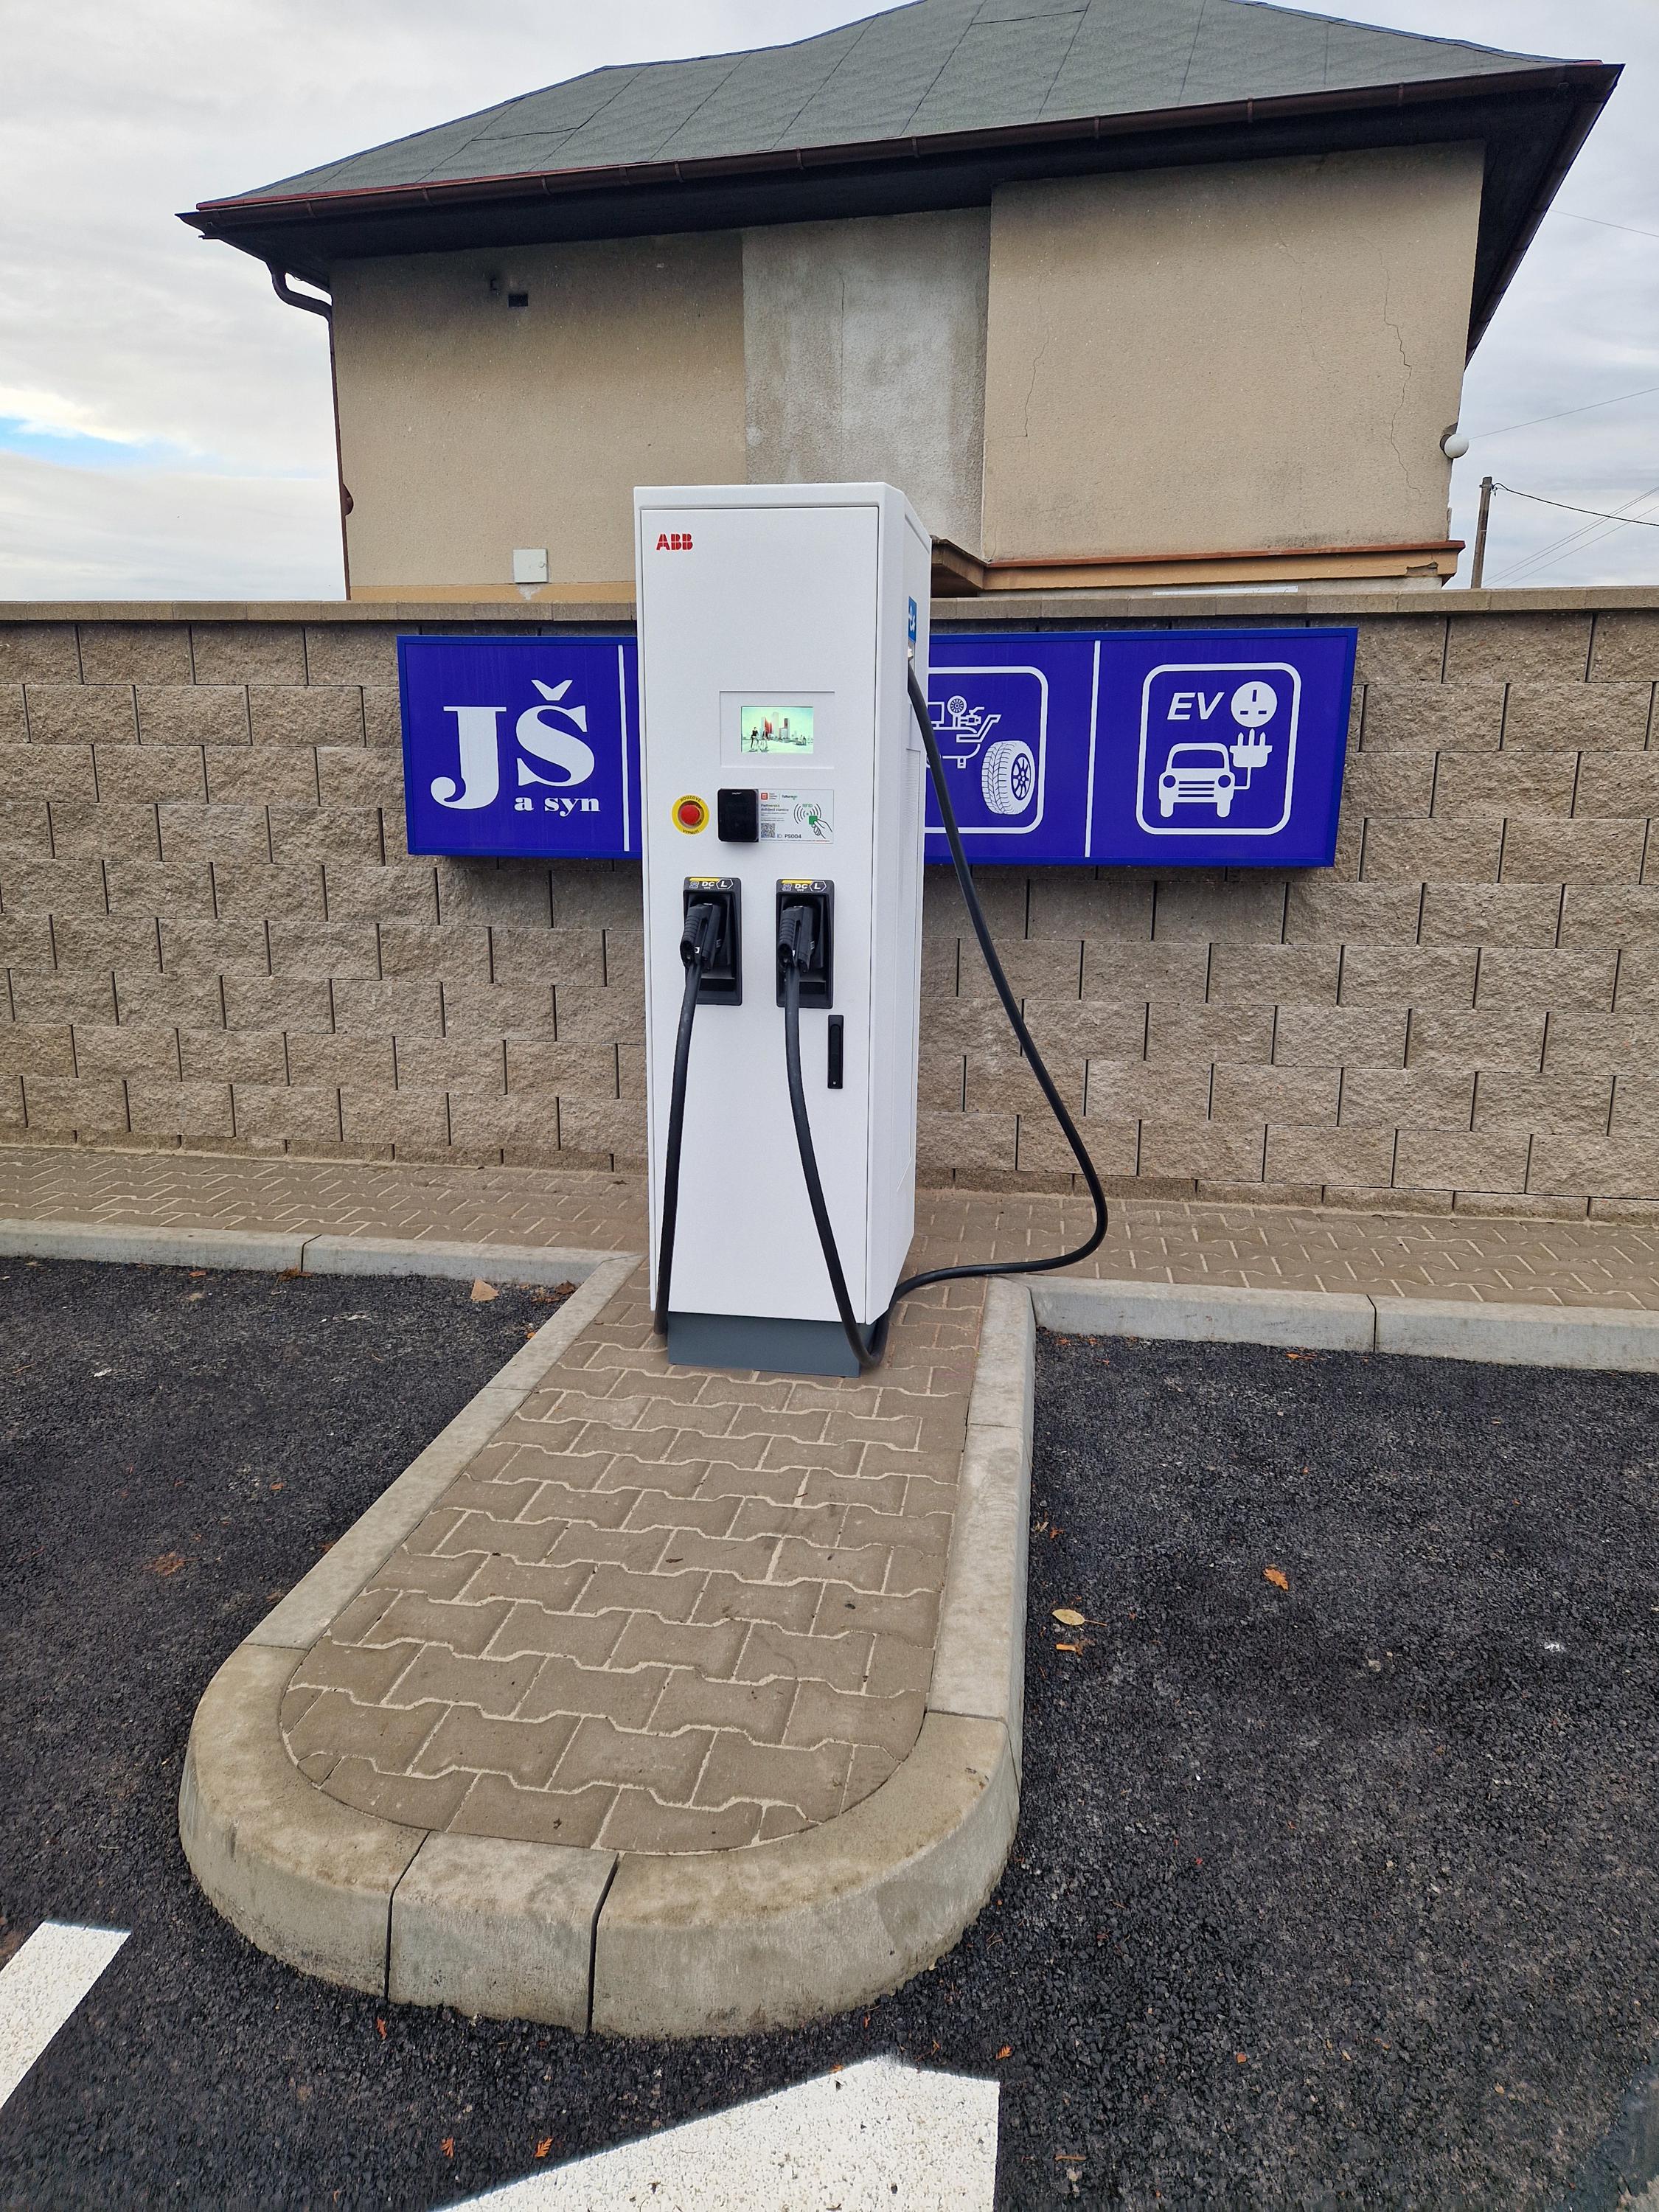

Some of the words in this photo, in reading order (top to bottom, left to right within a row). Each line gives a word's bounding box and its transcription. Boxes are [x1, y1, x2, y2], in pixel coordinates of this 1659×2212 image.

[655, 533, 693, 551] ABB
[1167, 692, 1224, 720] EV
[431, 679, 595, 810] JŠ
[514, 796, 534, 812] a
[544, 796, 601, 817] syn
